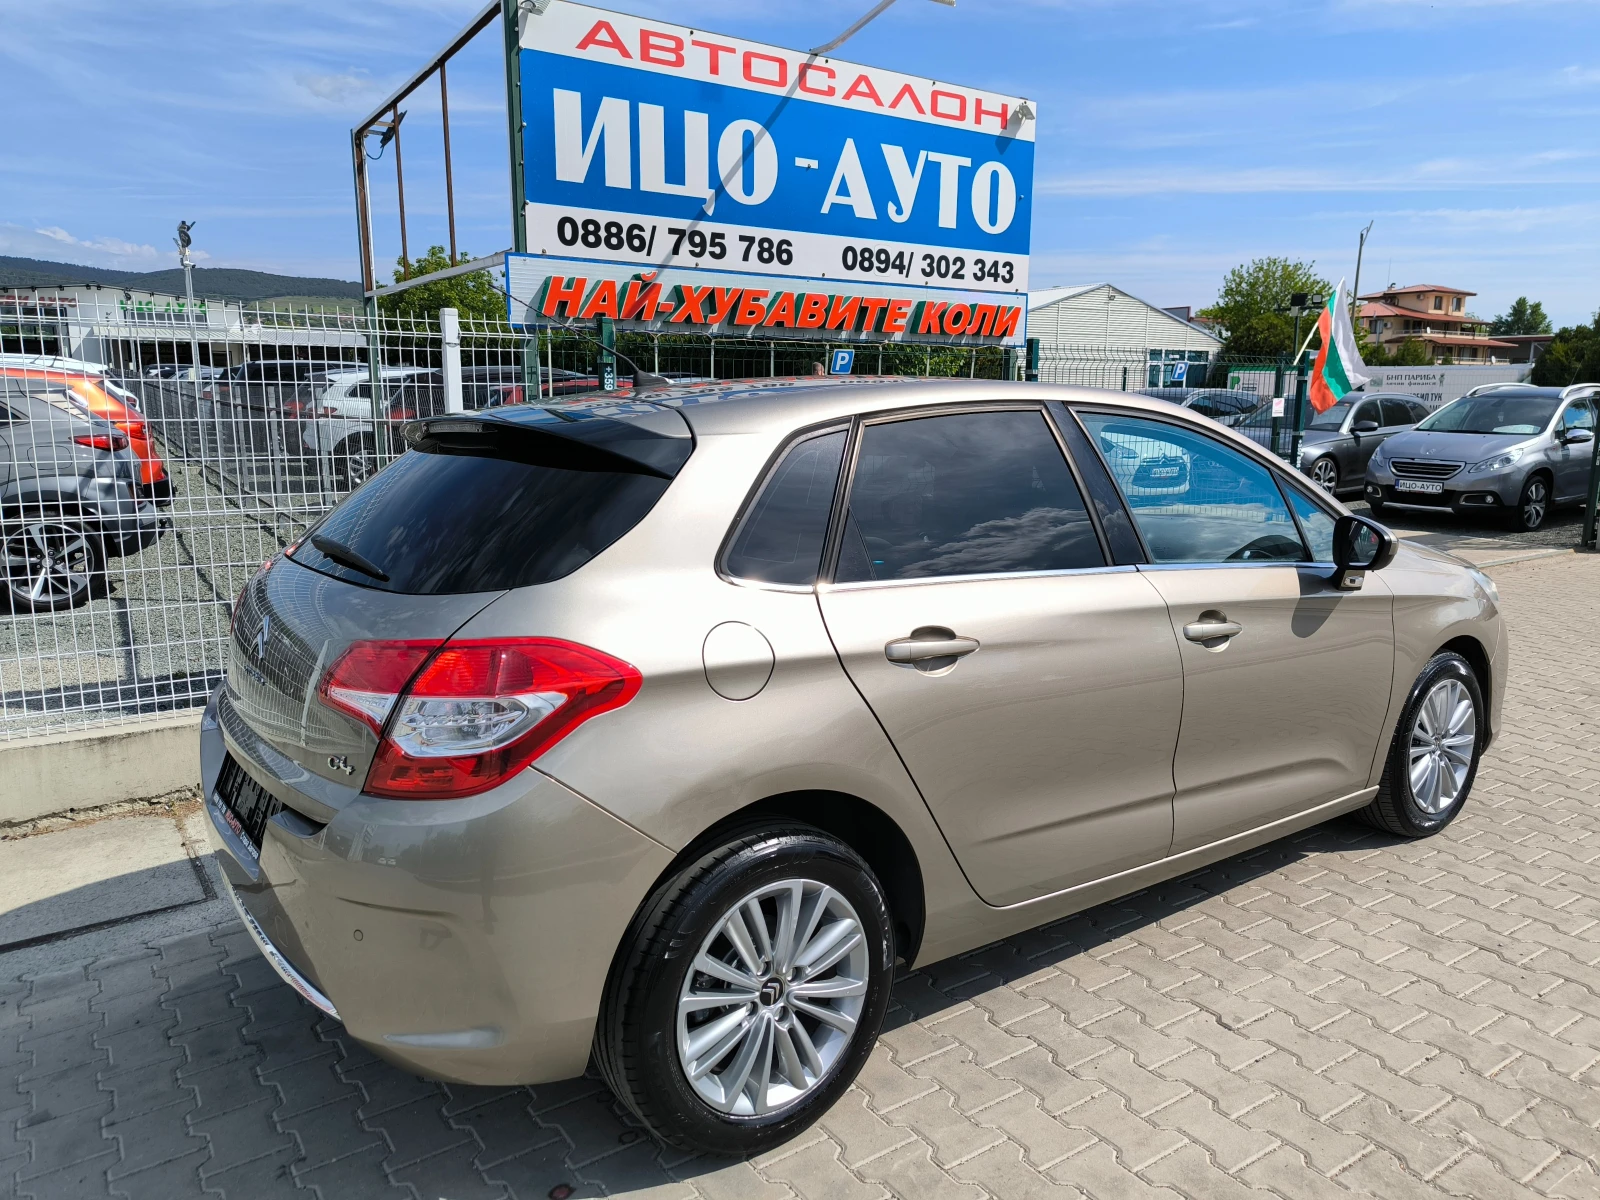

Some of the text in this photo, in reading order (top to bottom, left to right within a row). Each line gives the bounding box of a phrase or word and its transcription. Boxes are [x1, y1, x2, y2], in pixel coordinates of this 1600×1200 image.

[575, 19, 1008, 130] АВТОСАЛОН
[556, 215, 794, 266] 0886/ 795 786
[841, 245, 1015, 284] 0894/ 302 343
[539, 271, 1021, 337] НАЙ-ХУБАВИТЕ КОЛИ
[835, 352, 850, 371] P
[1174, 363, 1186, 379] P
[604, 366, 614, 391] +359
[1404, 374, 1436, 382] ПАРИБА
[1430, 393, 1443, 402] ТУК
[1399, 481, 1442, 491] ИЦО-АУТО
[327, 755, 356, 776] C4
